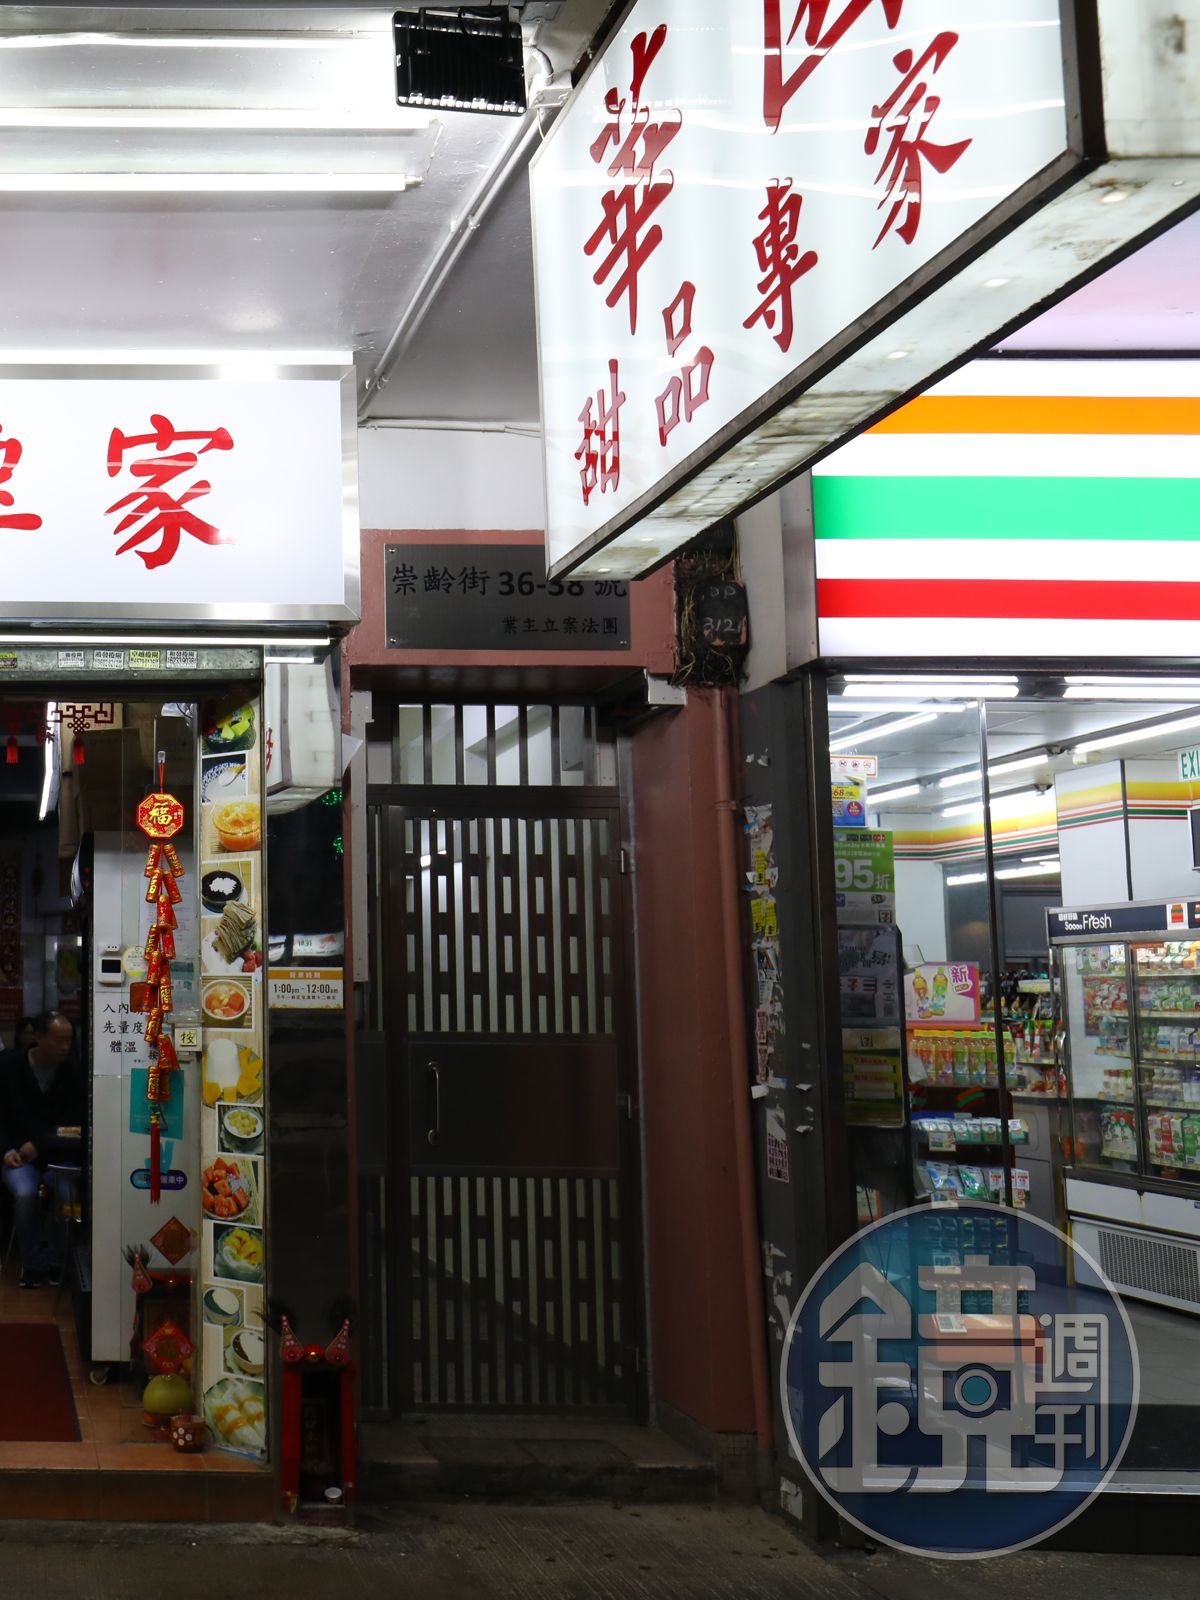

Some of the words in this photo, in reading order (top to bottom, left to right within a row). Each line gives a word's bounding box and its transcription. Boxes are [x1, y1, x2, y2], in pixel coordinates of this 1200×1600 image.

[576, 32, 971, 502] 甜品專家
[392, 563, 488, 596] 崇齡街
[498, 571, 585, 597] 36-38
[502, 616, 619, 635] 業主立案法團
[1181, 750, 1200, 779] EXI
[149, 802, 172, 825] 福
[1083, 914, 1111, 929] Fresh
[951, 966, 967, 983] 新
[274, 984, 299, 995] 1:00pm
[103, 1022, 144, 1035] 先量度
[182, 1031, 196, 1044] 按
[110, 1041, 138, 1053] 體溫
